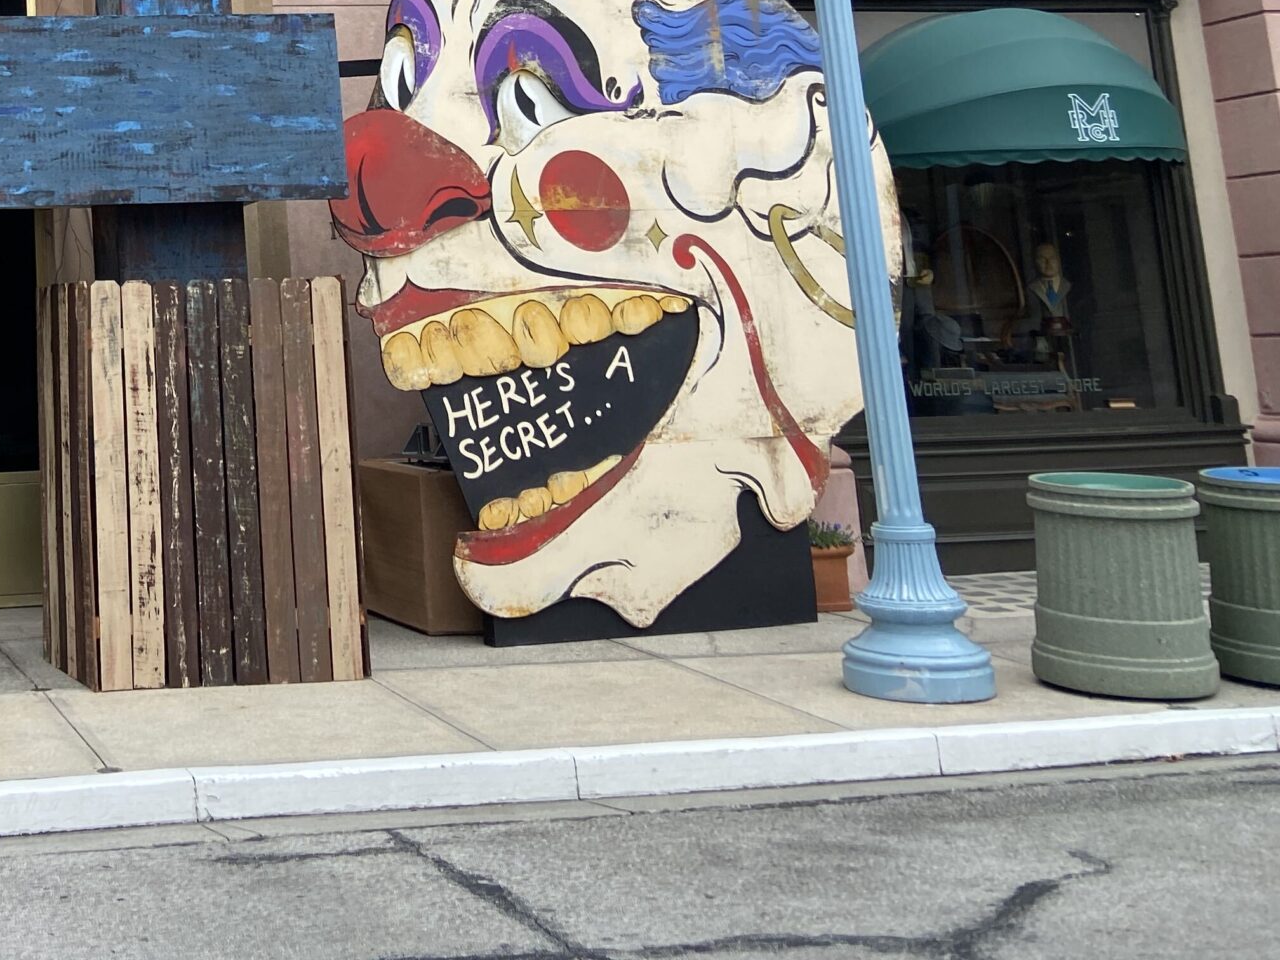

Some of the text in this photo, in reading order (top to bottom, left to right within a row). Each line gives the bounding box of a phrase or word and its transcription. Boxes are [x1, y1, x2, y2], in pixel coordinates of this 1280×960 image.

[442, 345, 635, 438] HERE'S A
[983, 380, 1046, 395] LARGEST
[458, 400, 612, 479] SECRET...
